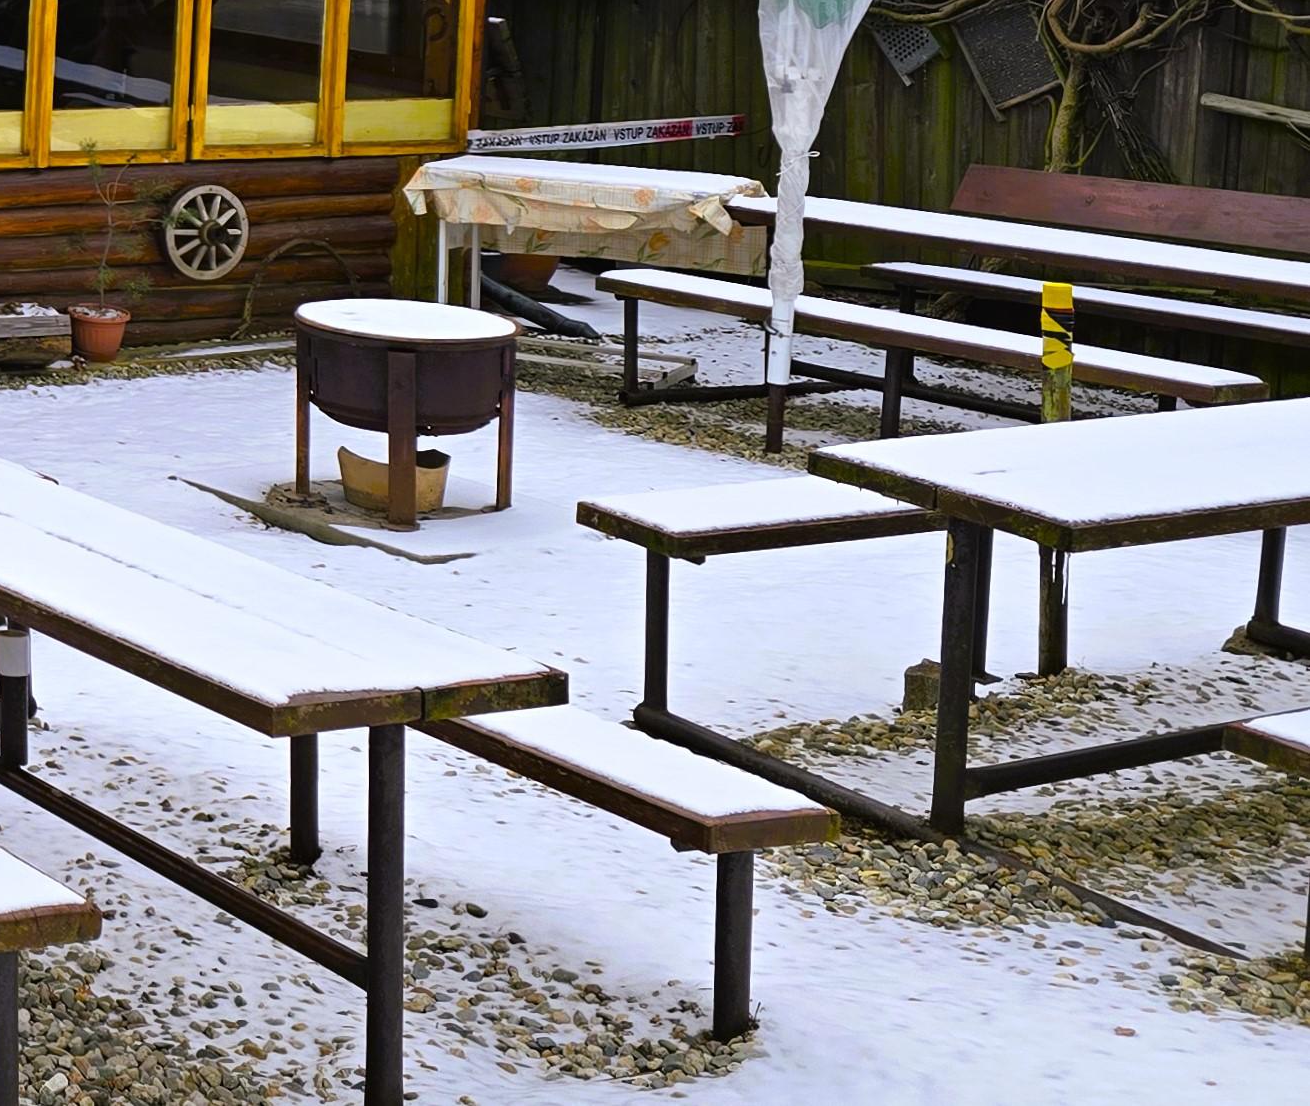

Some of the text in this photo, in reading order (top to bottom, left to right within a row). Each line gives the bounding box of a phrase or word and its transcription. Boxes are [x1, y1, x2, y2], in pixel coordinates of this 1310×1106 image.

[563, 127, 607, 144] ZAKÁZÁN
[613, 127, 644, 141] VSTUP
[695, 122, 725, 135] VSTUP
